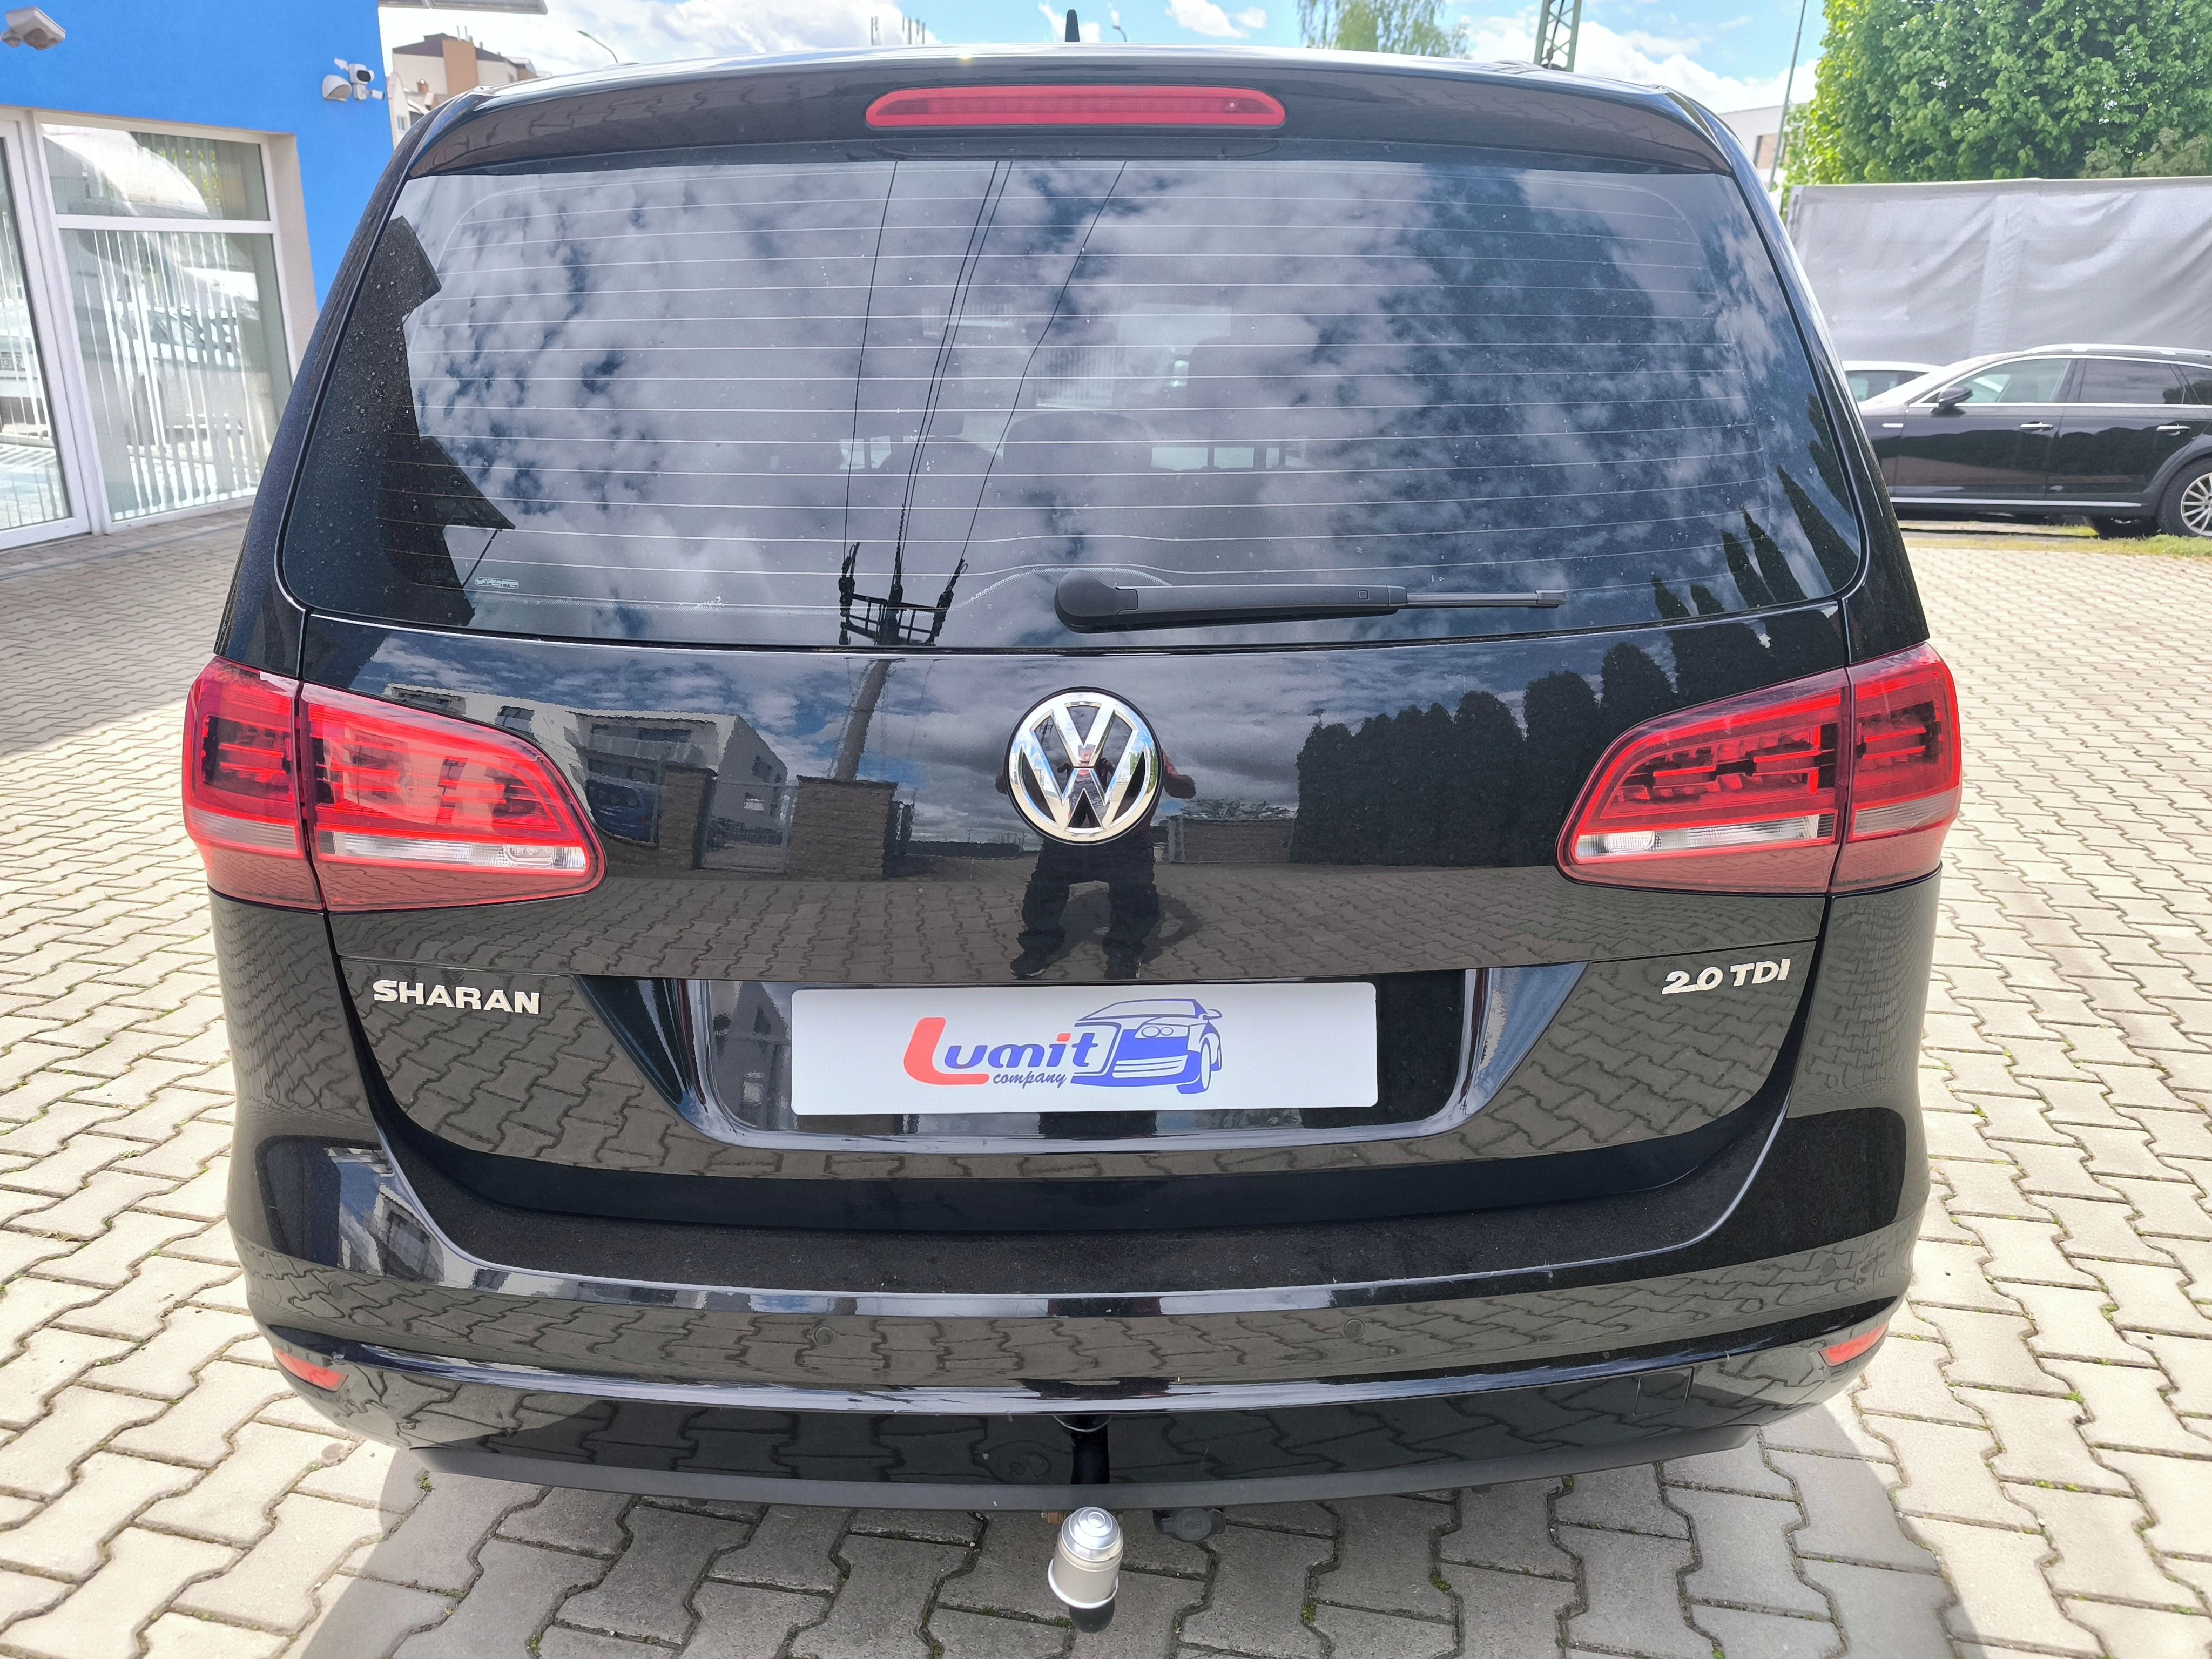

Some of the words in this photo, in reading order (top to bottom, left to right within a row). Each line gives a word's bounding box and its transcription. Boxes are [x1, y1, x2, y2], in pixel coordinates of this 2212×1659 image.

[1661, 967, 1723, 994] 2.0
[1730, 958, 1791, 986] TDI
[373, 980, 540, 1014] SHARAN
[903, 1017, 1098, 1085] Lumit
[993, 1071, 1067, 1089] company
